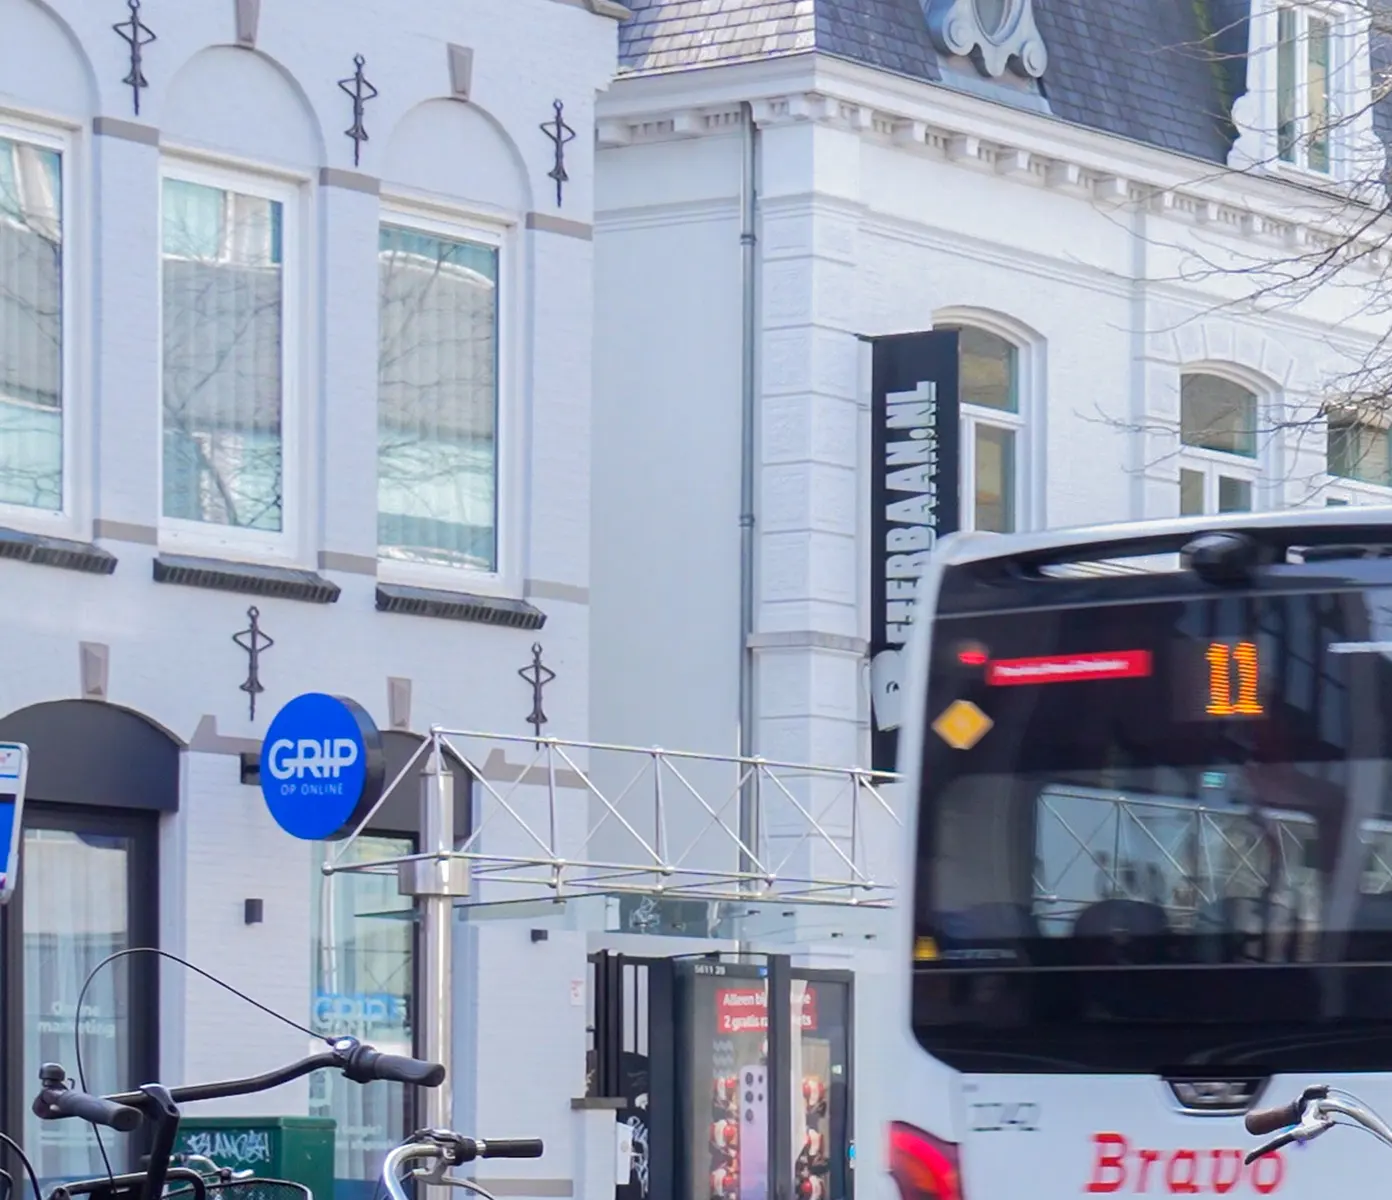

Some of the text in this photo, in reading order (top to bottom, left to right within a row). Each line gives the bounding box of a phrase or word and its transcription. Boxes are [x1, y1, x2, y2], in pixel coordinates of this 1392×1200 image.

[1204, 642, 1264, 716] 11
[268, 738, 358, 780] GRIP
[281, 782, 344, 796] OP ONLINE
[1084, 1131, 1286, 1194] Bravo
